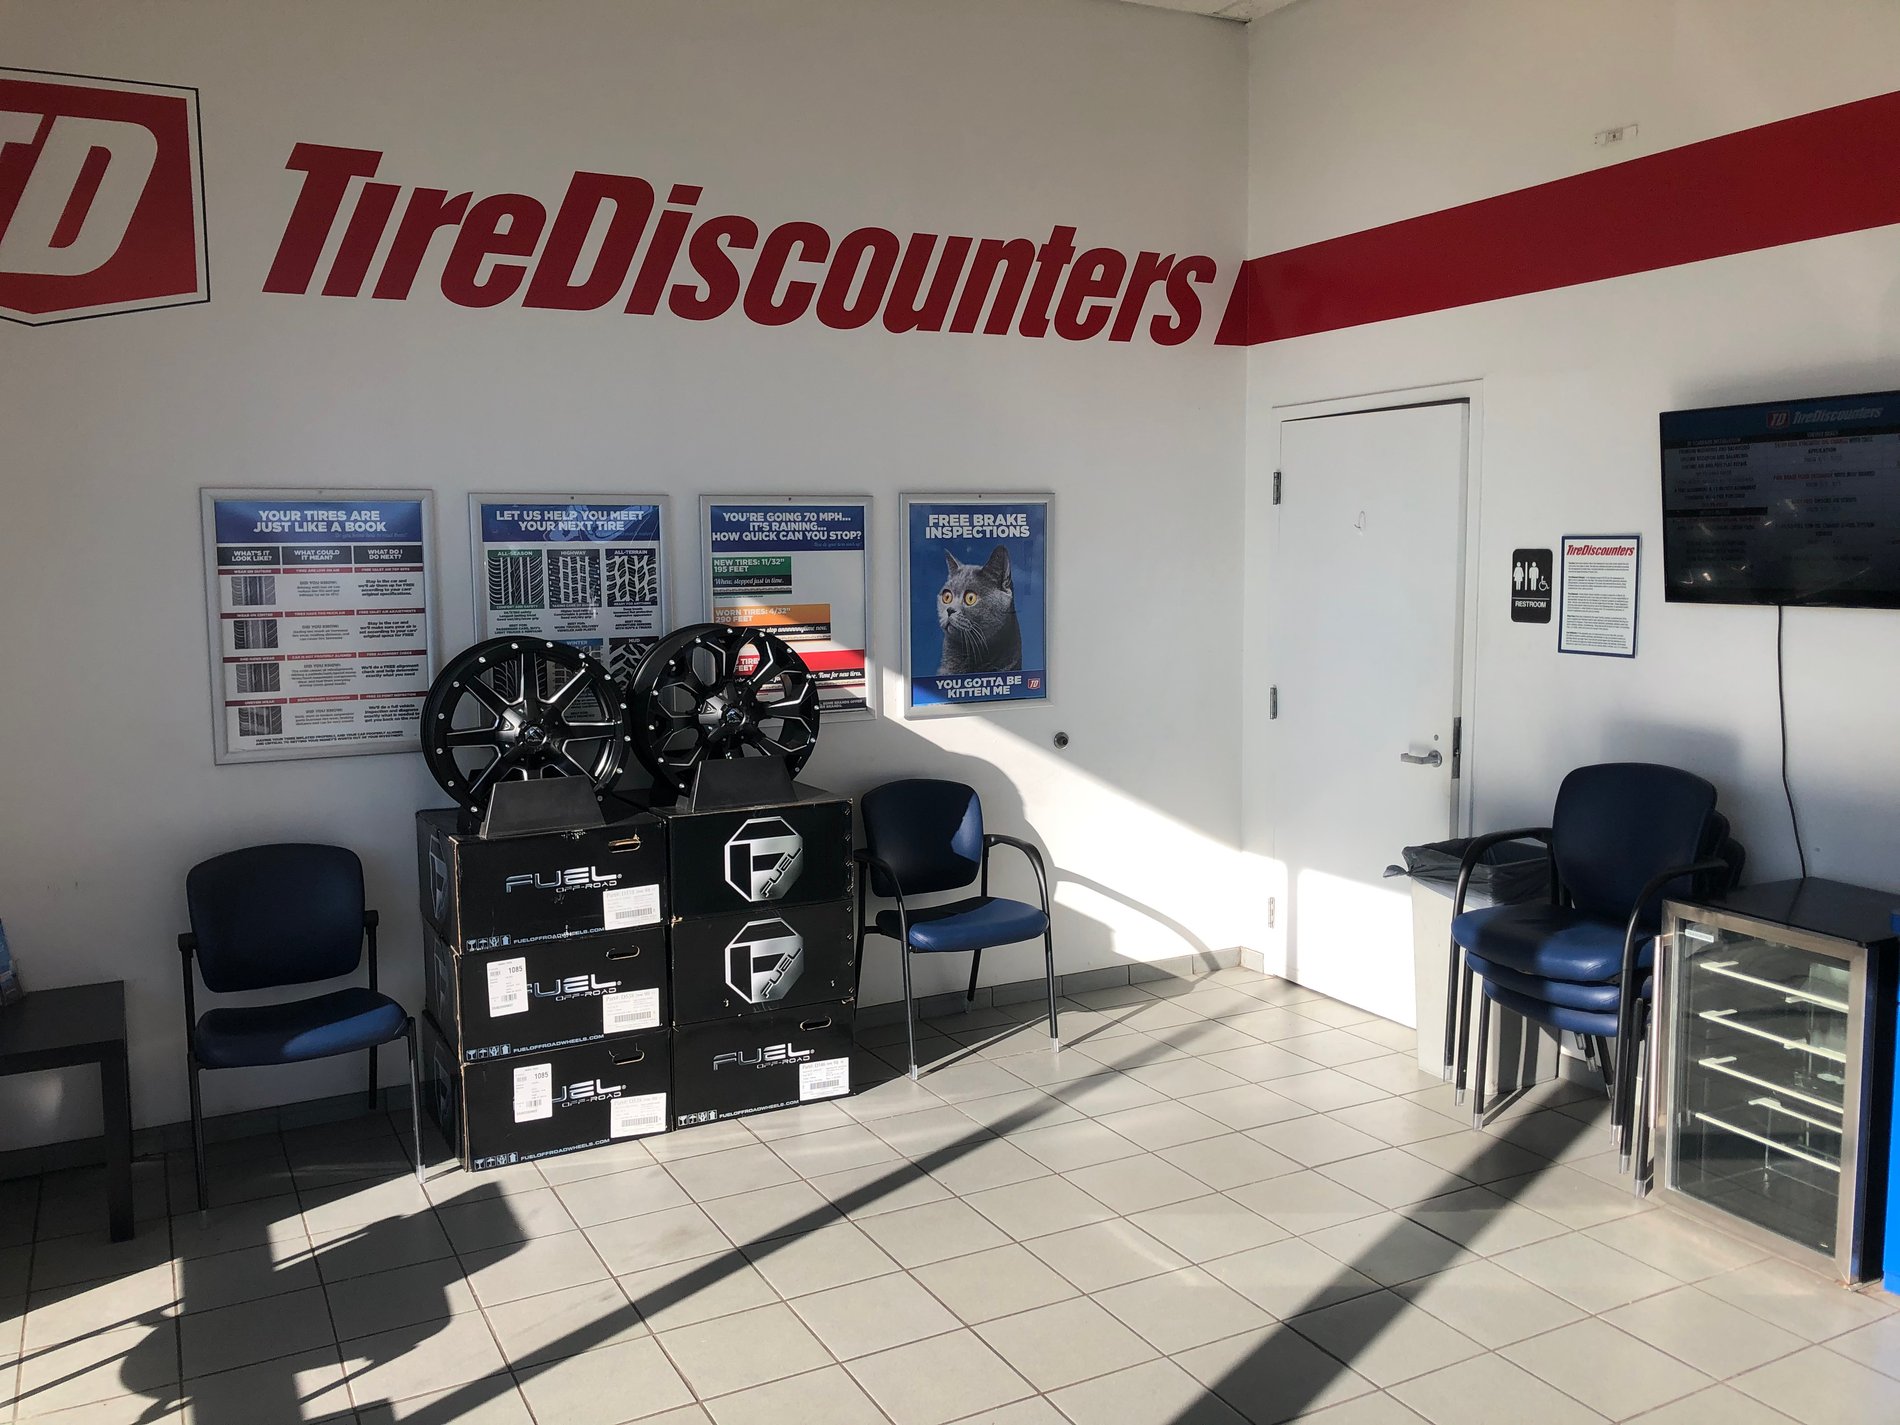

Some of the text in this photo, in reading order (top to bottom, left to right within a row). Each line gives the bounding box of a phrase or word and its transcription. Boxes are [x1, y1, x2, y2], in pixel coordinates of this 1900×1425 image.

[262, 142, 1217, 346] TireDiscounters
[258, 510, 380, 521] YOUR TIRES ARE
[496, 510, 644, 521] LET US HELP YOU MEET
[722, 512, 851, 522] YOU'RE GOING 70 MPH...
[928, 514, 1027, 526] FREE BRAKE
[253, 522, 387, 533] JUST LIKE A BOOK
[518, 521, 625, 531] YOUR NEXT TIRE
[749, 522, 827, 531] IT'S RAINING...
[925, 526, 1030, 539] INSPECTIONS
[712, 531, 862, 541] HOW QUICK CAN YOU STOP?
[1566, 545, 1634, 556] TireDiscounters
[936, 676, 1022, 690] YOU GOTTA BE
[947, 686, 1010, 698] KITTEN ME
[760, 847, 803, 898] FUEL
[506, 866, 617, 893] FUEL
[556, 880, 617, 893] OFF-ROAD
[508, 966, 523, 974] 1085
[760, 948, 803, 998] FUEL
[556, 987, 617, 1001] OFF-ROAD
[514, 1034, 604, 1053] FUELOFFROADWHEELS.COM
[713, 1042, 810, 1071] FUEL
[756, 1055, 810, 1069] OFF-ROAD
[534, 1072, 549, 1080] 1085
[562, 1091, 622, 1108] OFF-ROAD
[719, 1100, 800, 1118] FUELOFFROADWHEELS.COM
[520, 1138, 610, 1161] FUELOFFROADWHEELS.COM
